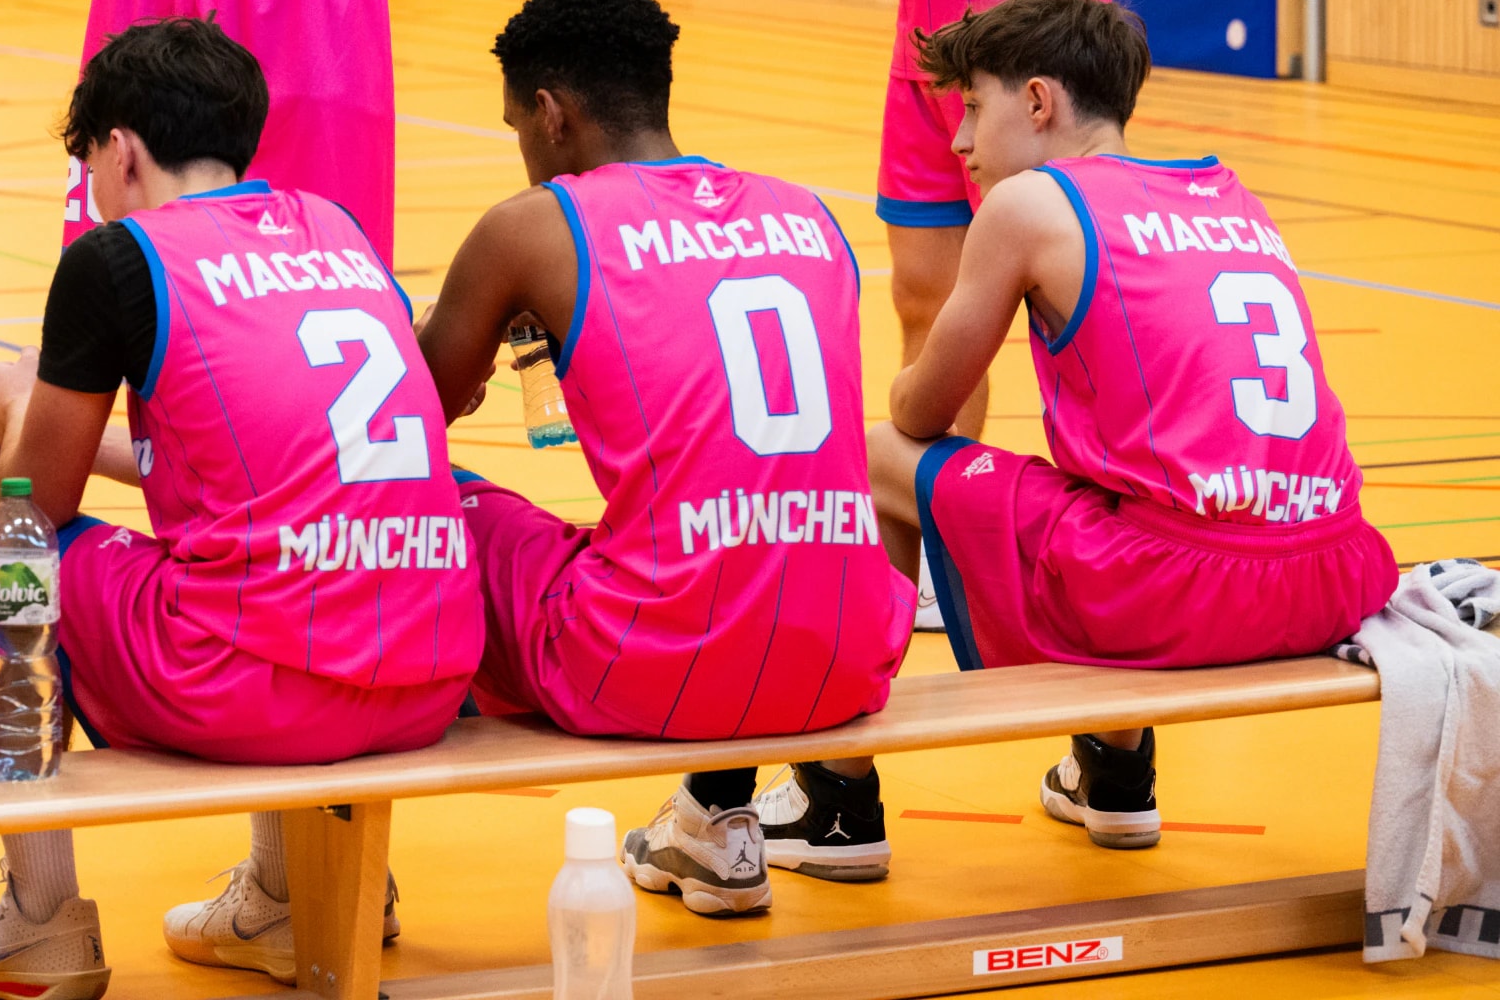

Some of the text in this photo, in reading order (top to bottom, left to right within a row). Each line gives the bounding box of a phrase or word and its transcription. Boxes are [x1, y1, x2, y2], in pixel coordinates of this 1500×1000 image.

[618, 212, 833, 271] MACCABI
[296, 307, 430, 485] 2
[706, 273, 833, 457] 0
[1208, 271, 1318, 441] 3
[276, 512, 467, 572] MÜNCHEN
[678, 487, 879, 555] MÜNCHEN
